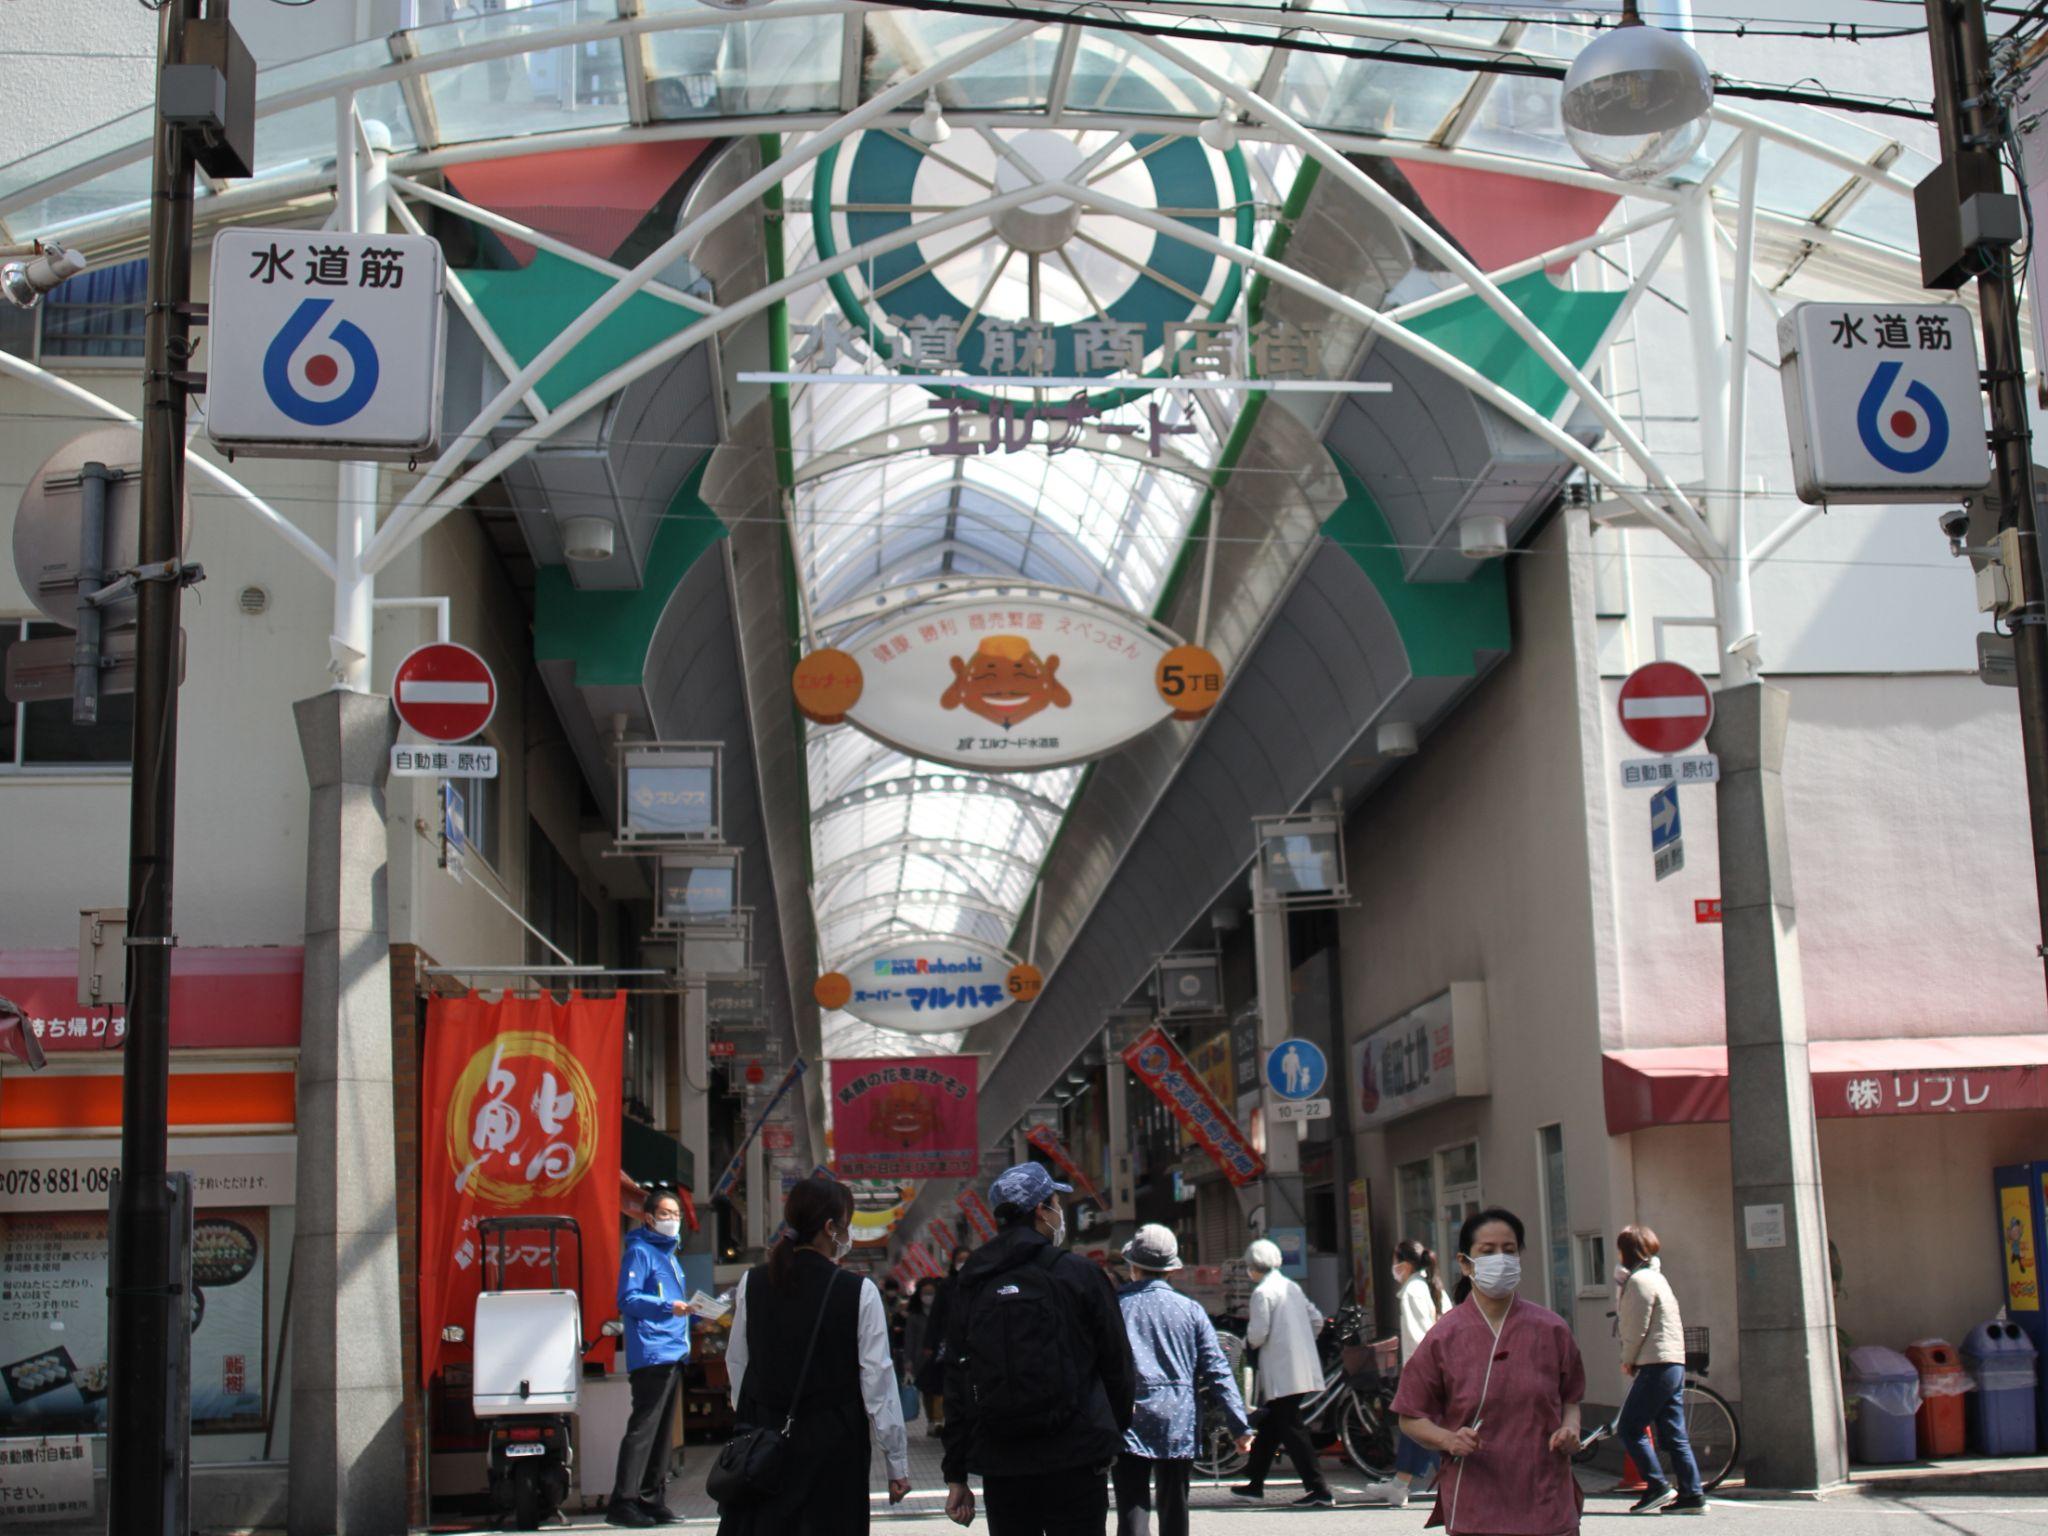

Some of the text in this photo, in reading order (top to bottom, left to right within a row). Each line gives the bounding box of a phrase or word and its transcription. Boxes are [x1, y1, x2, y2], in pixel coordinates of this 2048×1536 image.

[249, 243, 405, 289] 水道筋
[790, 313, 1326, 379] 水道筋商店街
[1830, 313, 1952, 350] 水道筋
[263, 298, 380, 426] 6
[1857, 361, 1949, 474] 6
[871, 634, 912, 664] 健康
[918, 617, 958, 644] 勝利
[1162, 665, 1219, 696] 5丁目
[905, 983, 1004, 1012] マルハチ
